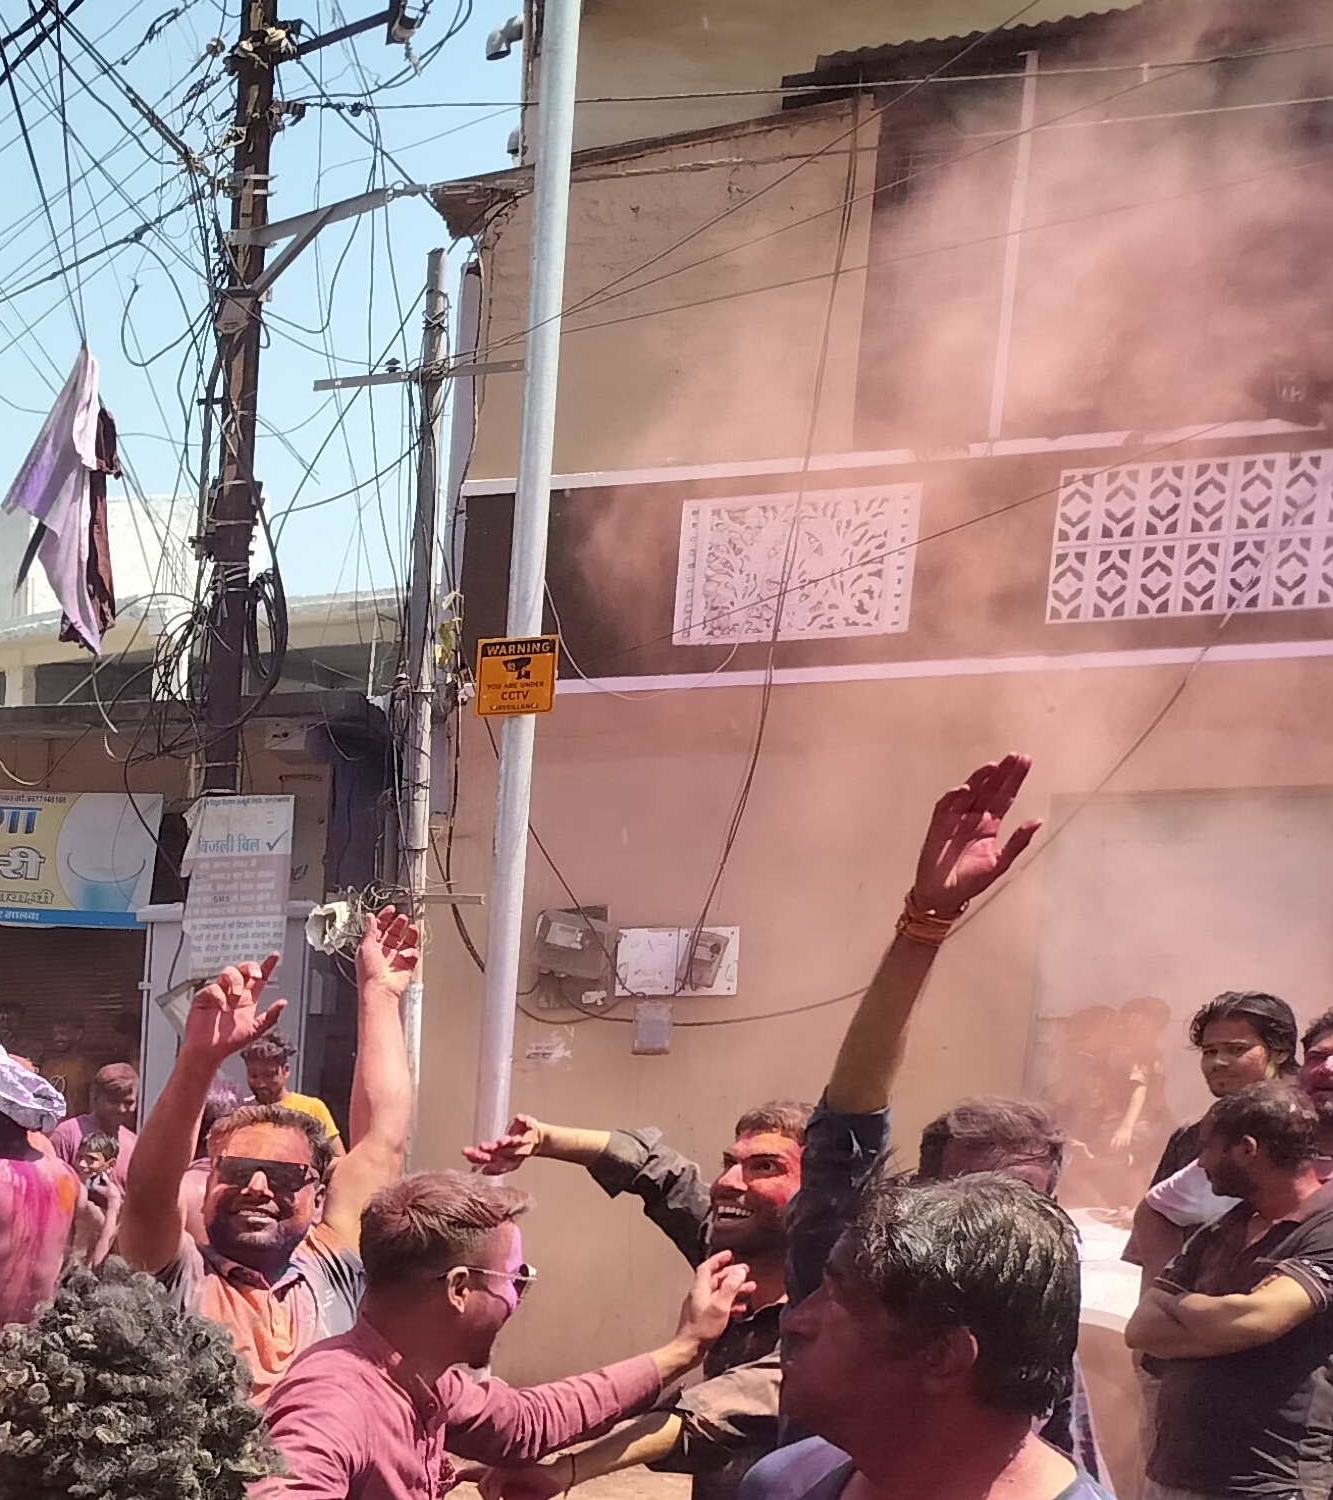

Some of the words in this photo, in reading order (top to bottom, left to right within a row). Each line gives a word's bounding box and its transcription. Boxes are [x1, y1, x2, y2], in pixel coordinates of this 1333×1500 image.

[487, 642, 550, 656] WARNING
[501, 690, 529, 700] CCTV
[213, 895, 230, 904] SMS
